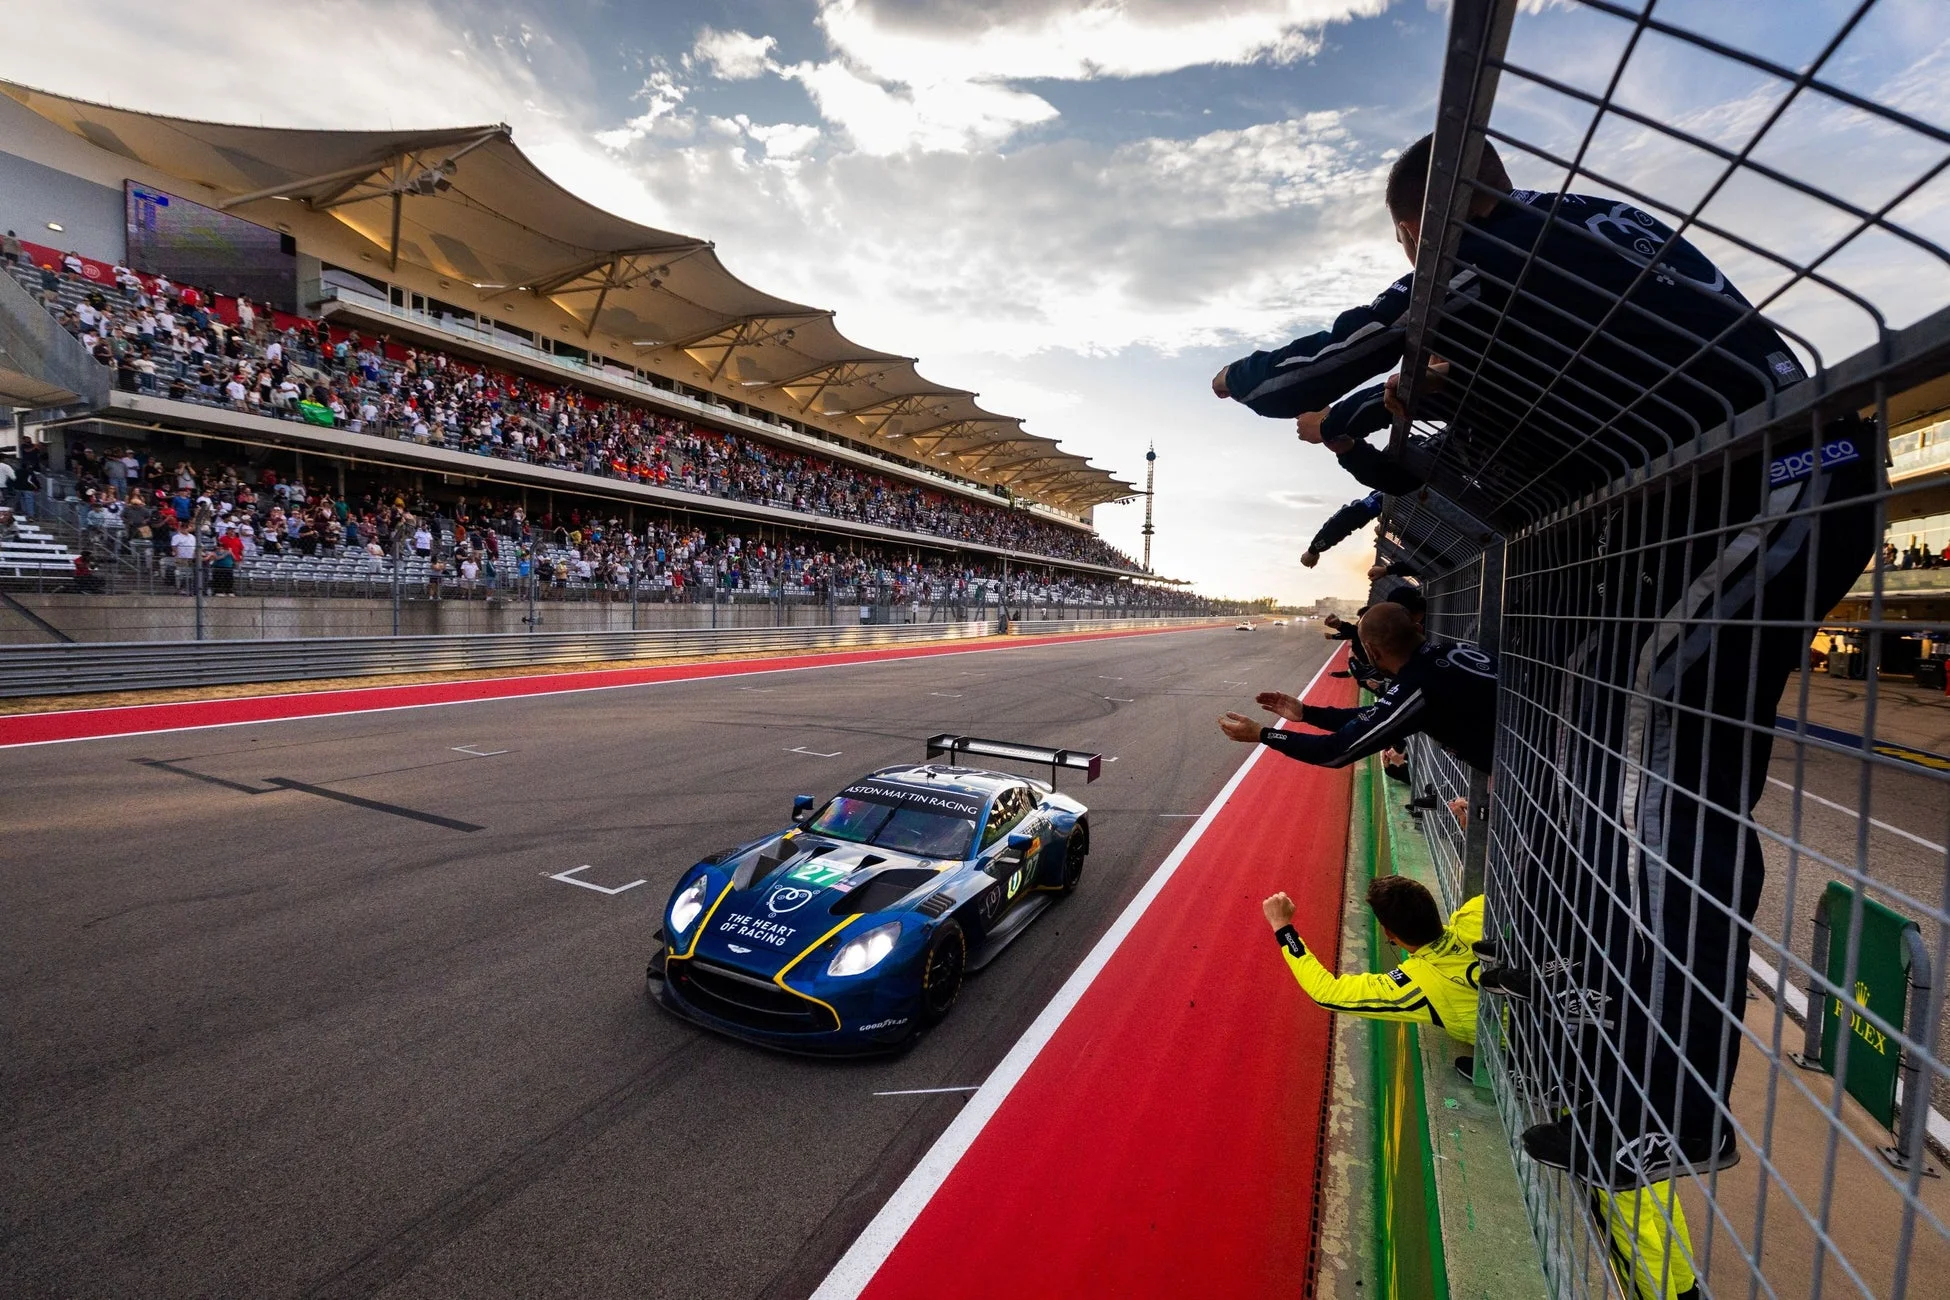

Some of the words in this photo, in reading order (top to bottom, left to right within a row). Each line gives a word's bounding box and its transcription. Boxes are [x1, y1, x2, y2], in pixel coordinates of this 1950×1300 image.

[1770, 441, 1854, 478] spaco
[844, 786, 882, 796] ASTON
[929, 797, 978, 815] RACING
[793, 865, 844, 883] 27
[719, 922, 738, 932] OF
[737, 926, 786, 946] RACING
[727, 913, 753, 925] THE
[752, 919, 797, 937] HEART
[1833, 998, 1887, 1056] RLEX
